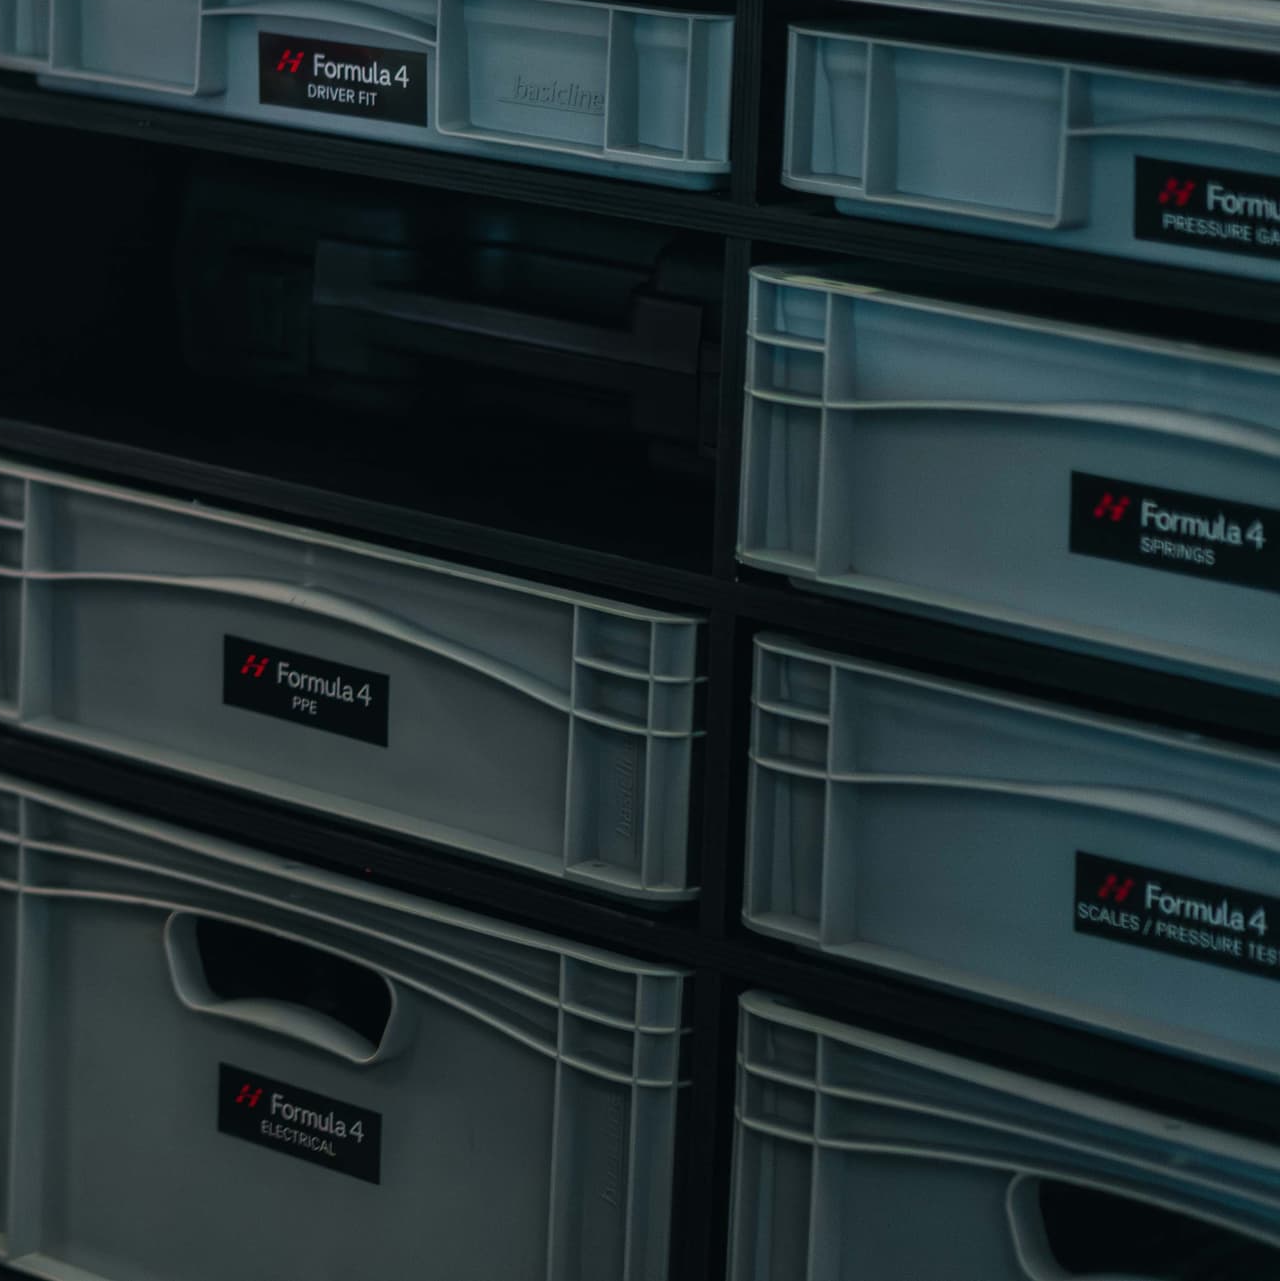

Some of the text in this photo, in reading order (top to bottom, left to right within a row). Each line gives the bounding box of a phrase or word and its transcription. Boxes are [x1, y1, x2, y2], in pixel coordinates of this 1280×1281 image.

[312, 52, 392, 87] Formula
[394, 64, 411, 89] 4
[307, 83, 378, 107] DRIVER FIT
[1206, 180, 1280, 221] Formu
[1162, 211, 1280, 247] PRESSURE GA
[1140, 498, 1244, 546] Formula
[1245, 519, 1267, 551] 4
[1140, 535, 1216, 566] SPRINGS
[276, 661, 355, 703] Formula
[356, 682, 373, 708] 4
[291, 695, 318, 715] PPE
[1144, 880, 1246, 932] Formula
[1247, 905, 1269, 937] 4
[1077, 902, 1140, 932] SCALES
[1154, 919, 1244, 957] PRESSURE
[1247, 941, 1280, 968] TES
[259, 1118, 336, 1157] ELECTRICAL
[270, 1092, 348, 1138] Formula
[349, 1120, 365, 1144] 4
